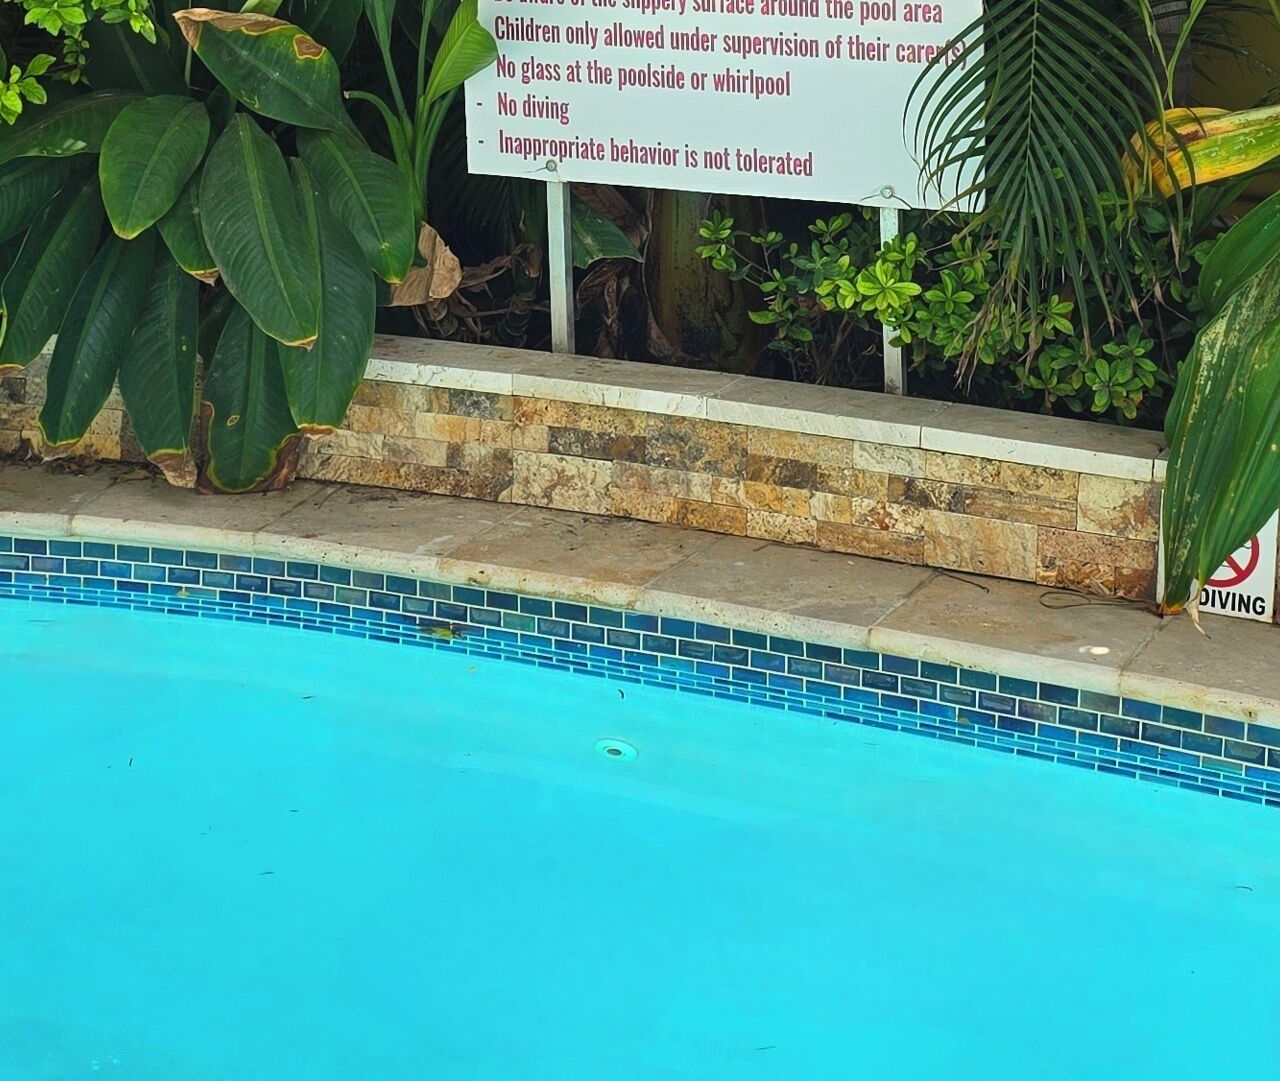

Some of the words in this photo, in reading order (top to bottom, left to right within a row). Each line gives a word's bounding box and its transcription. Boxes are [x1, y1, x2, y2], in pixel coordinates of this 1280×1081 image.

[903, 2, 943, 24] area
[494, 15, 560, 43] Children
[566, 21, 599, 50] only
[604, 22, 665, 49] allowed
[670, 27, 718, 52] under
[723, 31, 820, 59] supervision
[825, 34, 842, 59] of
[847, 35, 891, 62] their
[496, 54, 516, 79] No
[521, 56, 561, 85] glass
[566, 59, 582, 83] at
[586, 60, 612, 85] the
[618, 63, 685, 91] poolside
[690, 71, 708, 92] or
[713, 67, 791, 100] whirlpool
[497, 91, 517, 117] No
[522, 93, 570, 125] diving
[499, 129, 605, 163] Inappropriate
[610, 137, 680, 167] behavior
[684, 143, 698, 168] is
[703, 147, 731, 171] not
[735, 147, 813, 177] tolerated
[1199, 588, 1266, 615] DIVING
